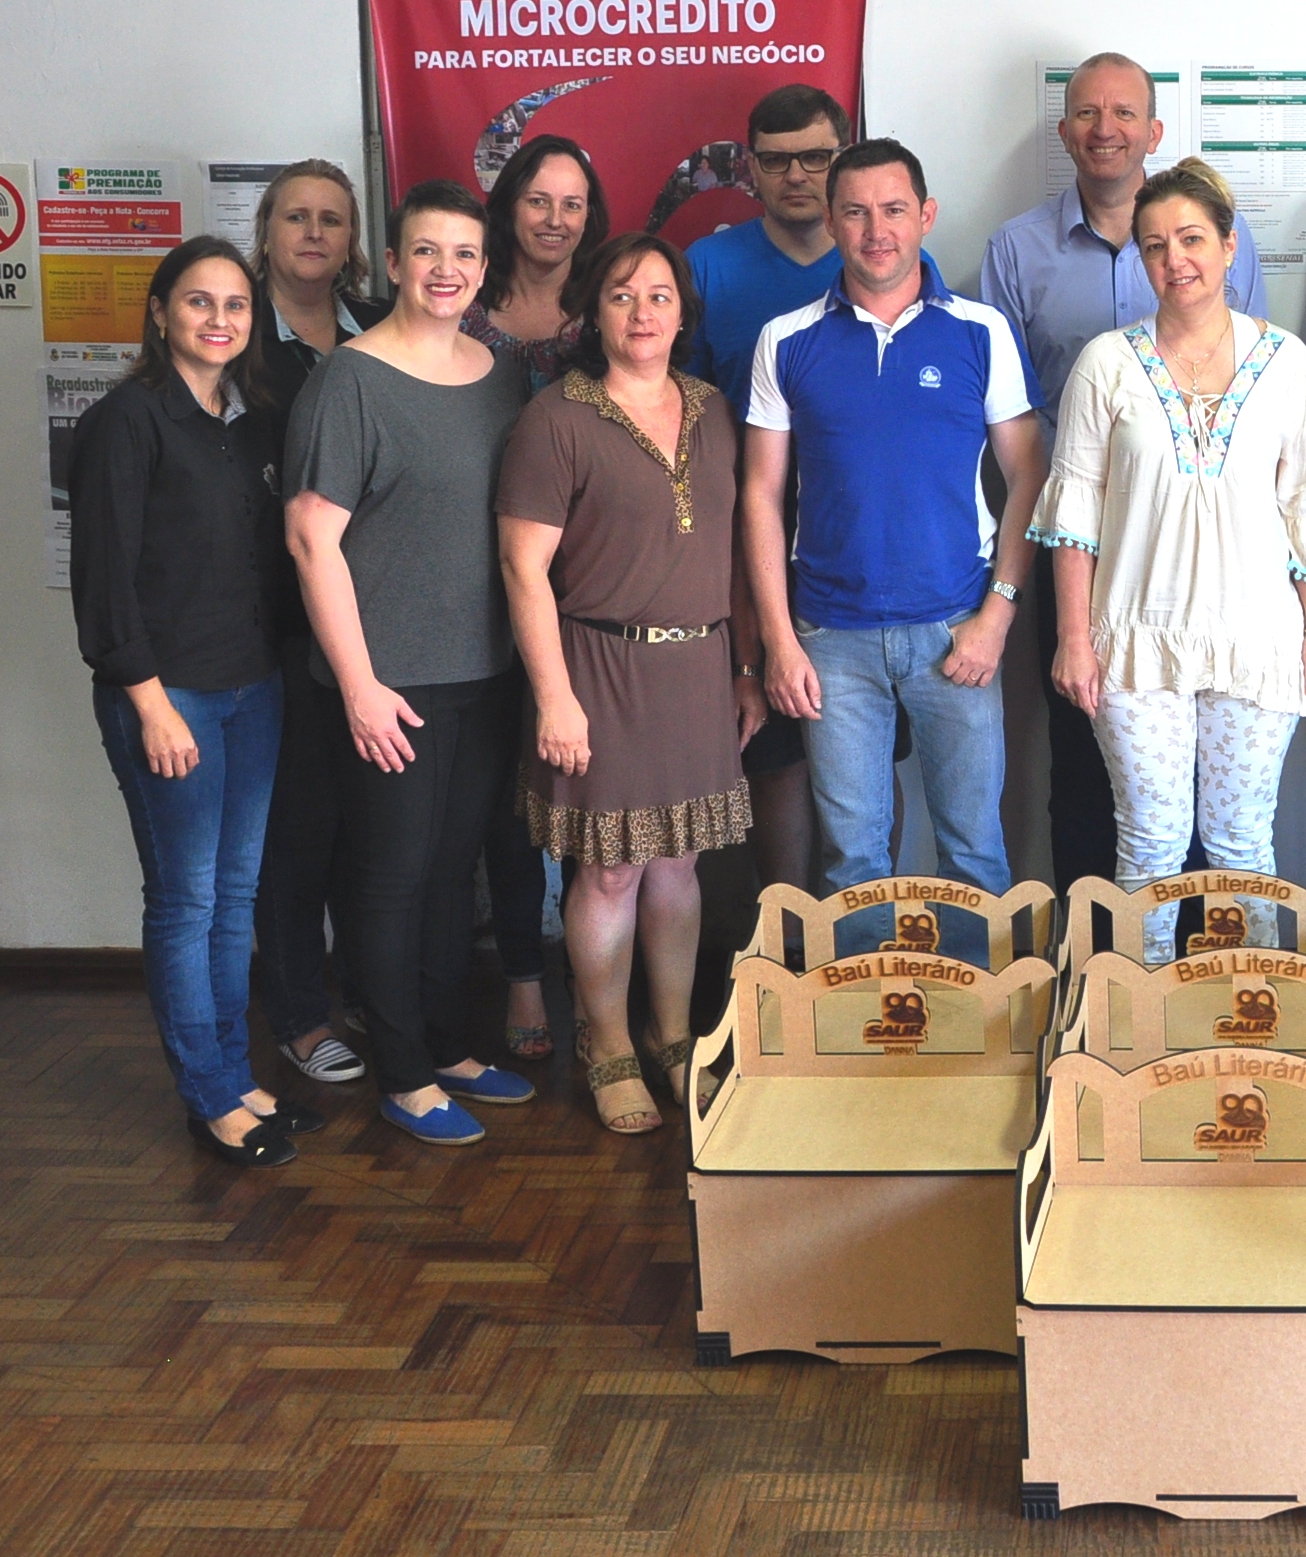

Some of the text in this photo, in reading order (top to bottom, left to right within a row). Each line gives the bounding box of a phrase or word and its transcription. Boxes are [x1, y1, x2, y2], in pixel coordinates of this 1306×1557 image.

[414, 41, 825, 69] PARA FORTALECER O SEU NEGÓCIO
[86, 169, 161, 177] PROGRAMA DE
[87, 177, 163, 188] PREMIAÇÃO
[90, 207, 107, 216] Peça
[115, 207, 132, 215] Nota
[137, 207, 169, 215] Concorra
[46, 375, 113, 393] Recadastra
[52, 419, 68, 428] UM
[1152, 874, 1291, 902] Baú Literário
[842, 882, 982, 910] Baú Literário
[1190, 936, 1243, 948] SAUR
[823, 956, 976, 988] Baú Literário
[1176, 955, 1224, 983] Baú
[866, 1024, 925, 1037] SAUR
[1217, 1020, 1275, 1033] SAUR
[1152, 1056, 1206, 1087] Baú
[1199, 1128, 1263, 1143] SAUR
